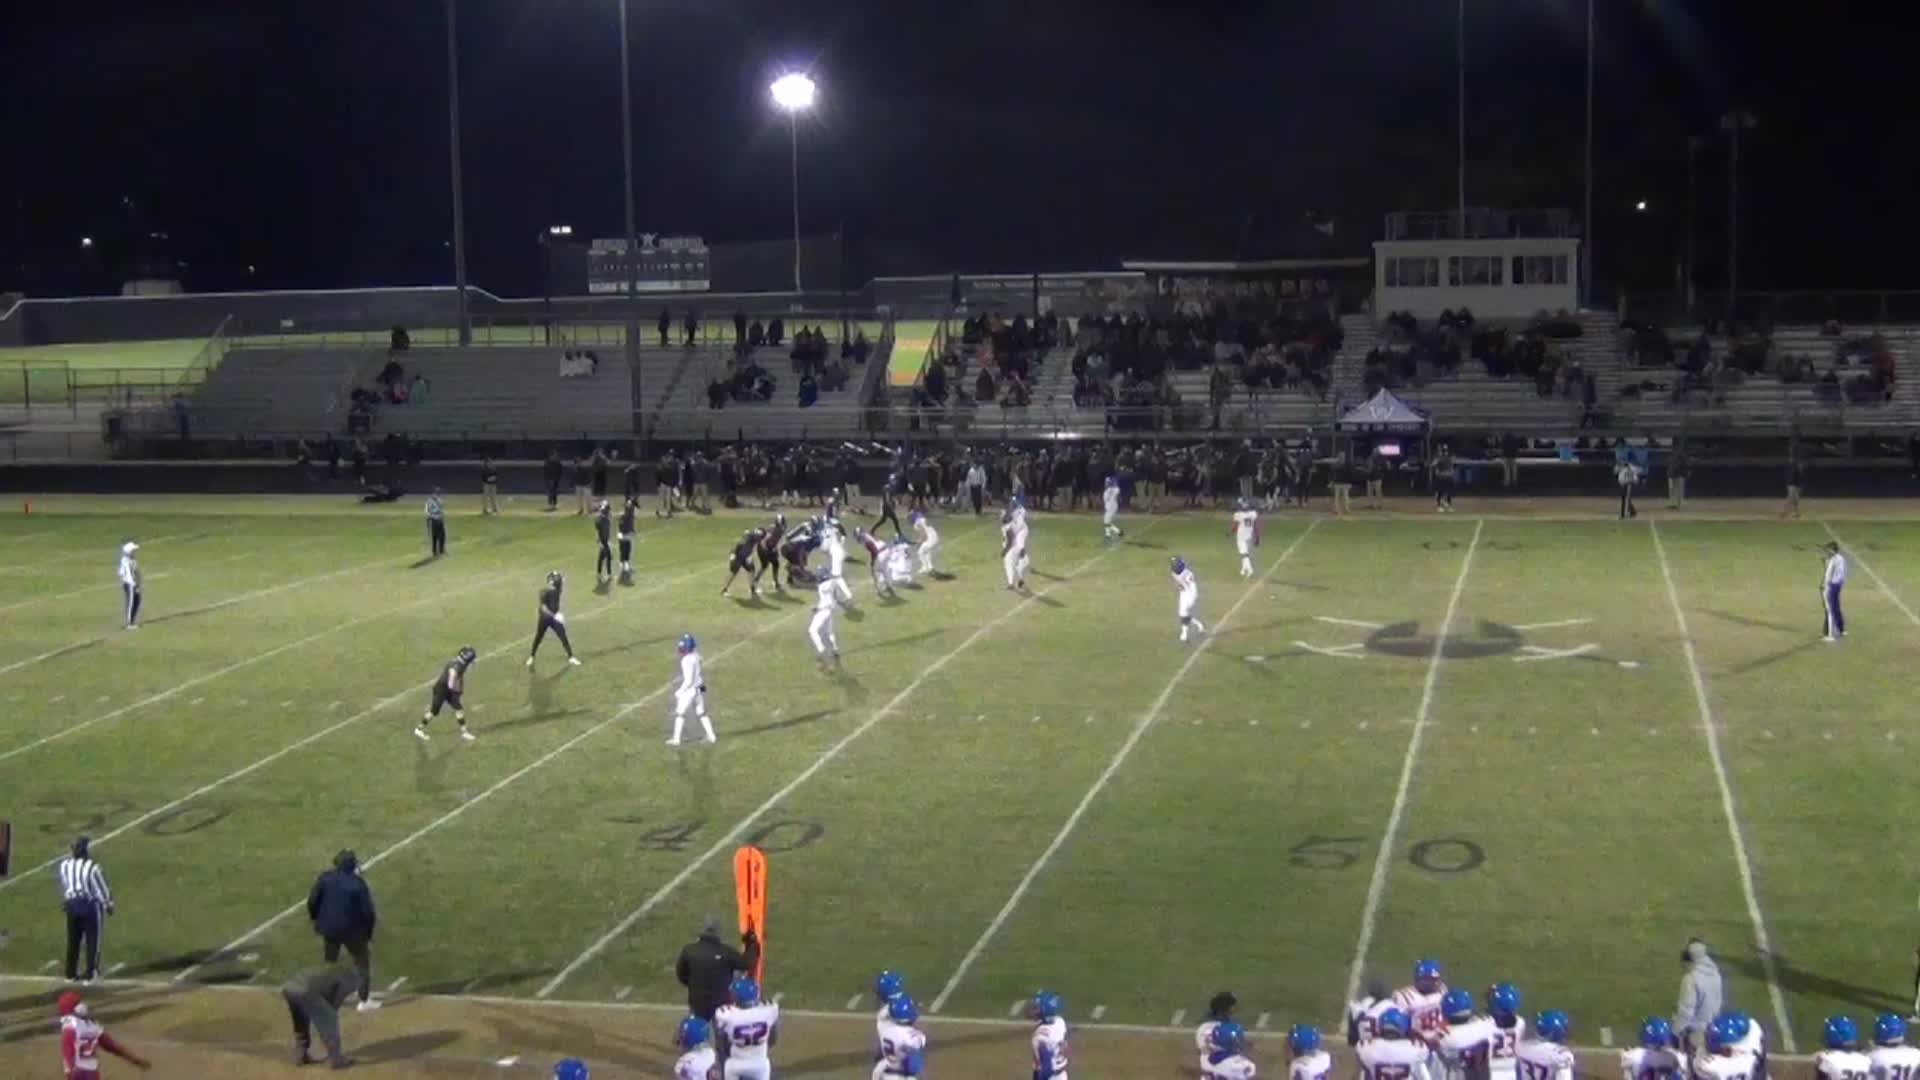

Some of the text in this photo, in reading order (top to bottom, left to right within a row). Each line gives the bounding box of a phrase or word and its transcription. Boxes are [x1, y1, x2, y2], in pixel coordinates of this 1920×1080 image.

[1289, 833, 1486, 873] 50
[733, 1022, 769, 1048] 52
[1492, 1034, 1516, 1058] 23
